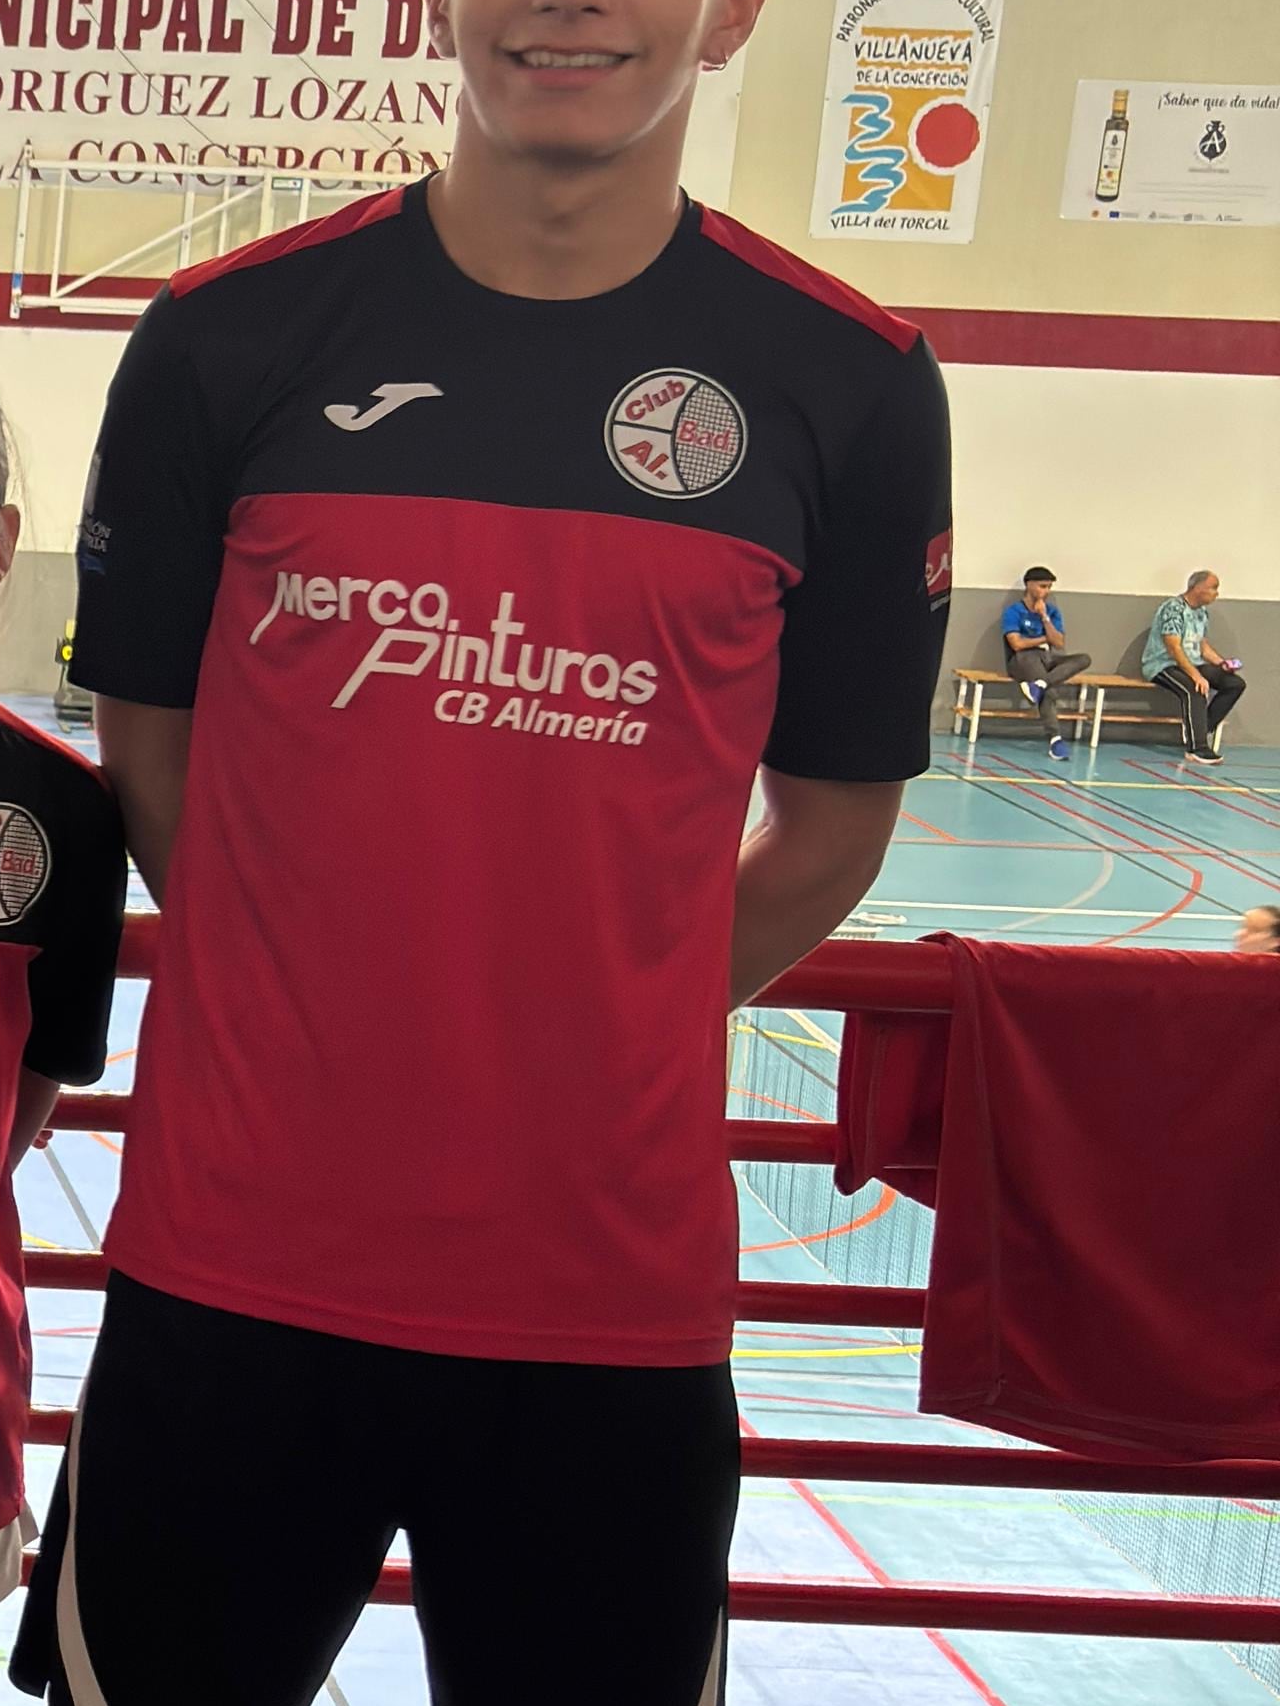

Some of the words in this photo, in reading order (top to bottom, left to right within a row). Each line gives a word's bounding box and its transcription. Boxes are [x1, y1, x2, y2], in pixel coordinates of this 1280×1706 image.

[853, 39, 973, 64] VILLANUEVA
[856, 69, 871, 84] DE
[874, 69, 890, 85] LA
[892, 69, 969, 88] CONCEPCIÓN
[249, 76, 460, 126] LOZAN
[1229, 94, 1247, 109] da
[830, 214, 870, 230] VILLA
[873, 215, 895, 229] del
[900, 216, 951, 231] TORCAL
[625, 379, 686, 421] Club
[331, 592, 659, 710] Pinturas
[434, 688, 486, 727] CB
[493, 695, 648, 747] Almería
